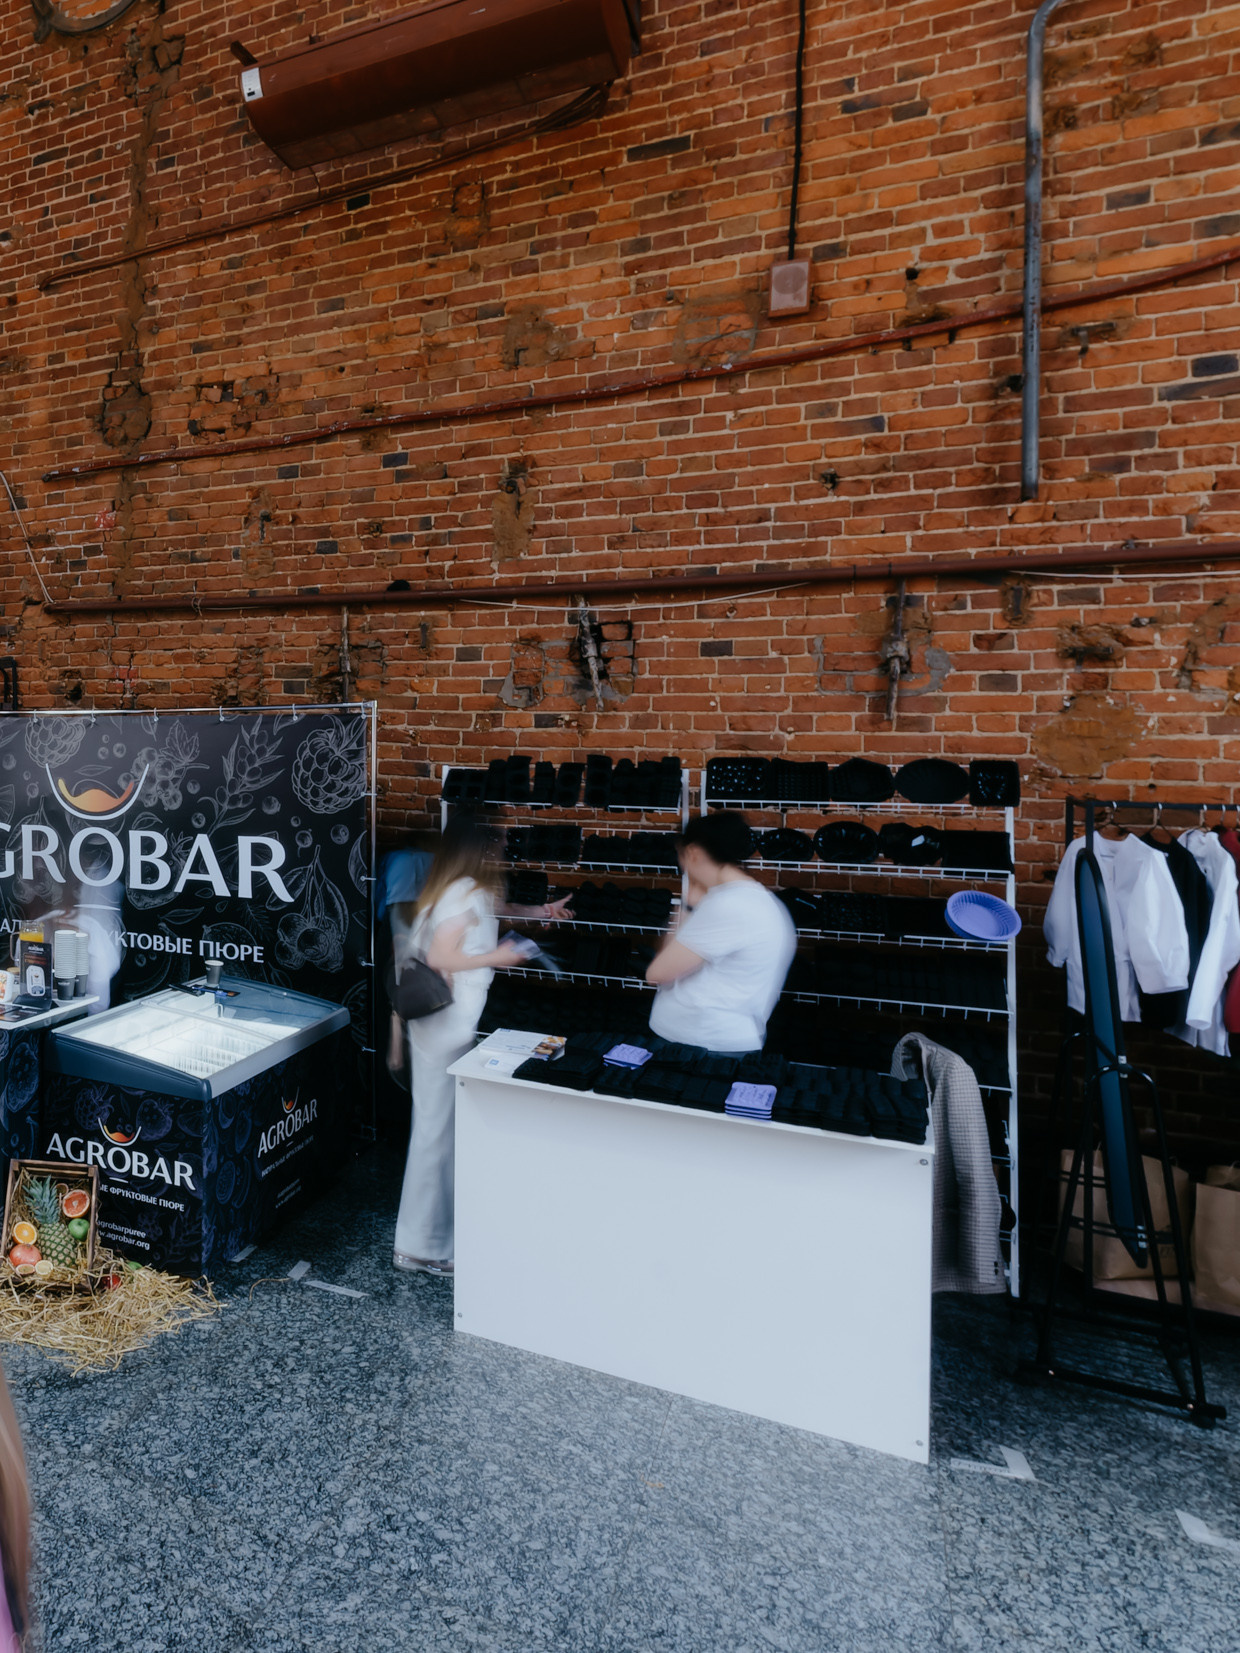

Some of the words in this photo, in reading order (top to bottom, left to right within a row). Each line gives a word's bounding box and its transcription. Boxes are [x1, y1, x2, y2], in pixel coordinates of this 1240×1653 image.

[109, 930, 193, 955] КТОВЫЕ
[198, 939, 264, 963] ПЮРЕ
[257, 1098, 318, 1158] AGROBAR
[46, 1132, 196, 1191] AGROBAR
[109, 1186, 158, 1206] ФРУКТОВЫЕ
[158, 1198, 185, 1212] ПЮРЕ
